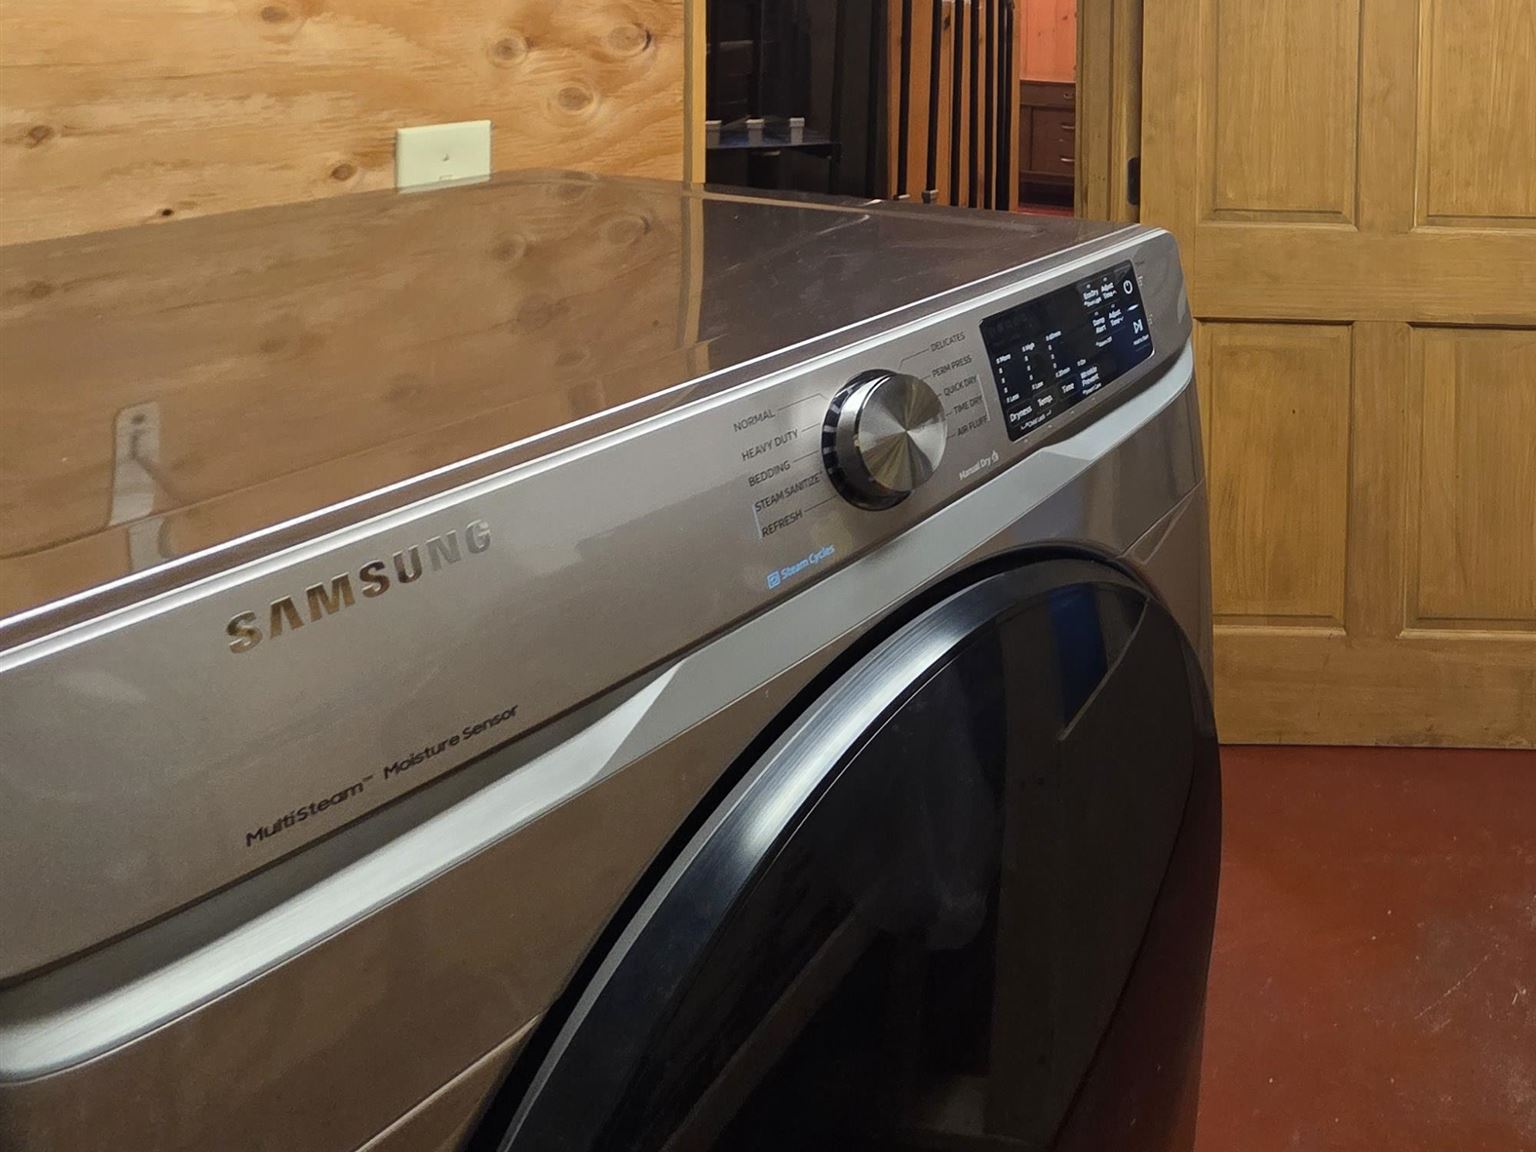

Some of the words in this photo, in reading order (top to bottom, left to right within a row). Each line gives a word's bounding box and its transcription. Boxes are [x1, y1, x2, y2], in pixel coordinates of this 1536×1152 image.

[930, 333, 966, 352] DELICATES
[931, 364, 951, 378] PERM
[951, 355, 973, 370] PRESS
[943, 382, 964, 397] QUICK
[963, 375, 978, 389] DRY
[954, 401, 969, 415] TIME
[967, 395, 982, 408] DRY
[1009, 405, 1033, 422] Dryness
[733, 409, 776, 433] NORMAL
[956, 424, 969, 437] AIR
[968, 415, 988, 432] FLUFF
[741, 440, 774, 462] HEAVY
[774, 428, 799, 448] DUTY
[747, 460, 791, 487] BEDDING
[980, 454, 992, 471] Dry
[754, 494, 785, 513] STEAM
[761, 509, 804, 539] REFRESH
[780, 558, 810, 579] Steam
[809, 545, 836, 566] Cycles
[224, 518, 493, 654] SAMSUNG
[383, 734, 461, 780] Moisture
[462, 704, 519, 741] Sensor
